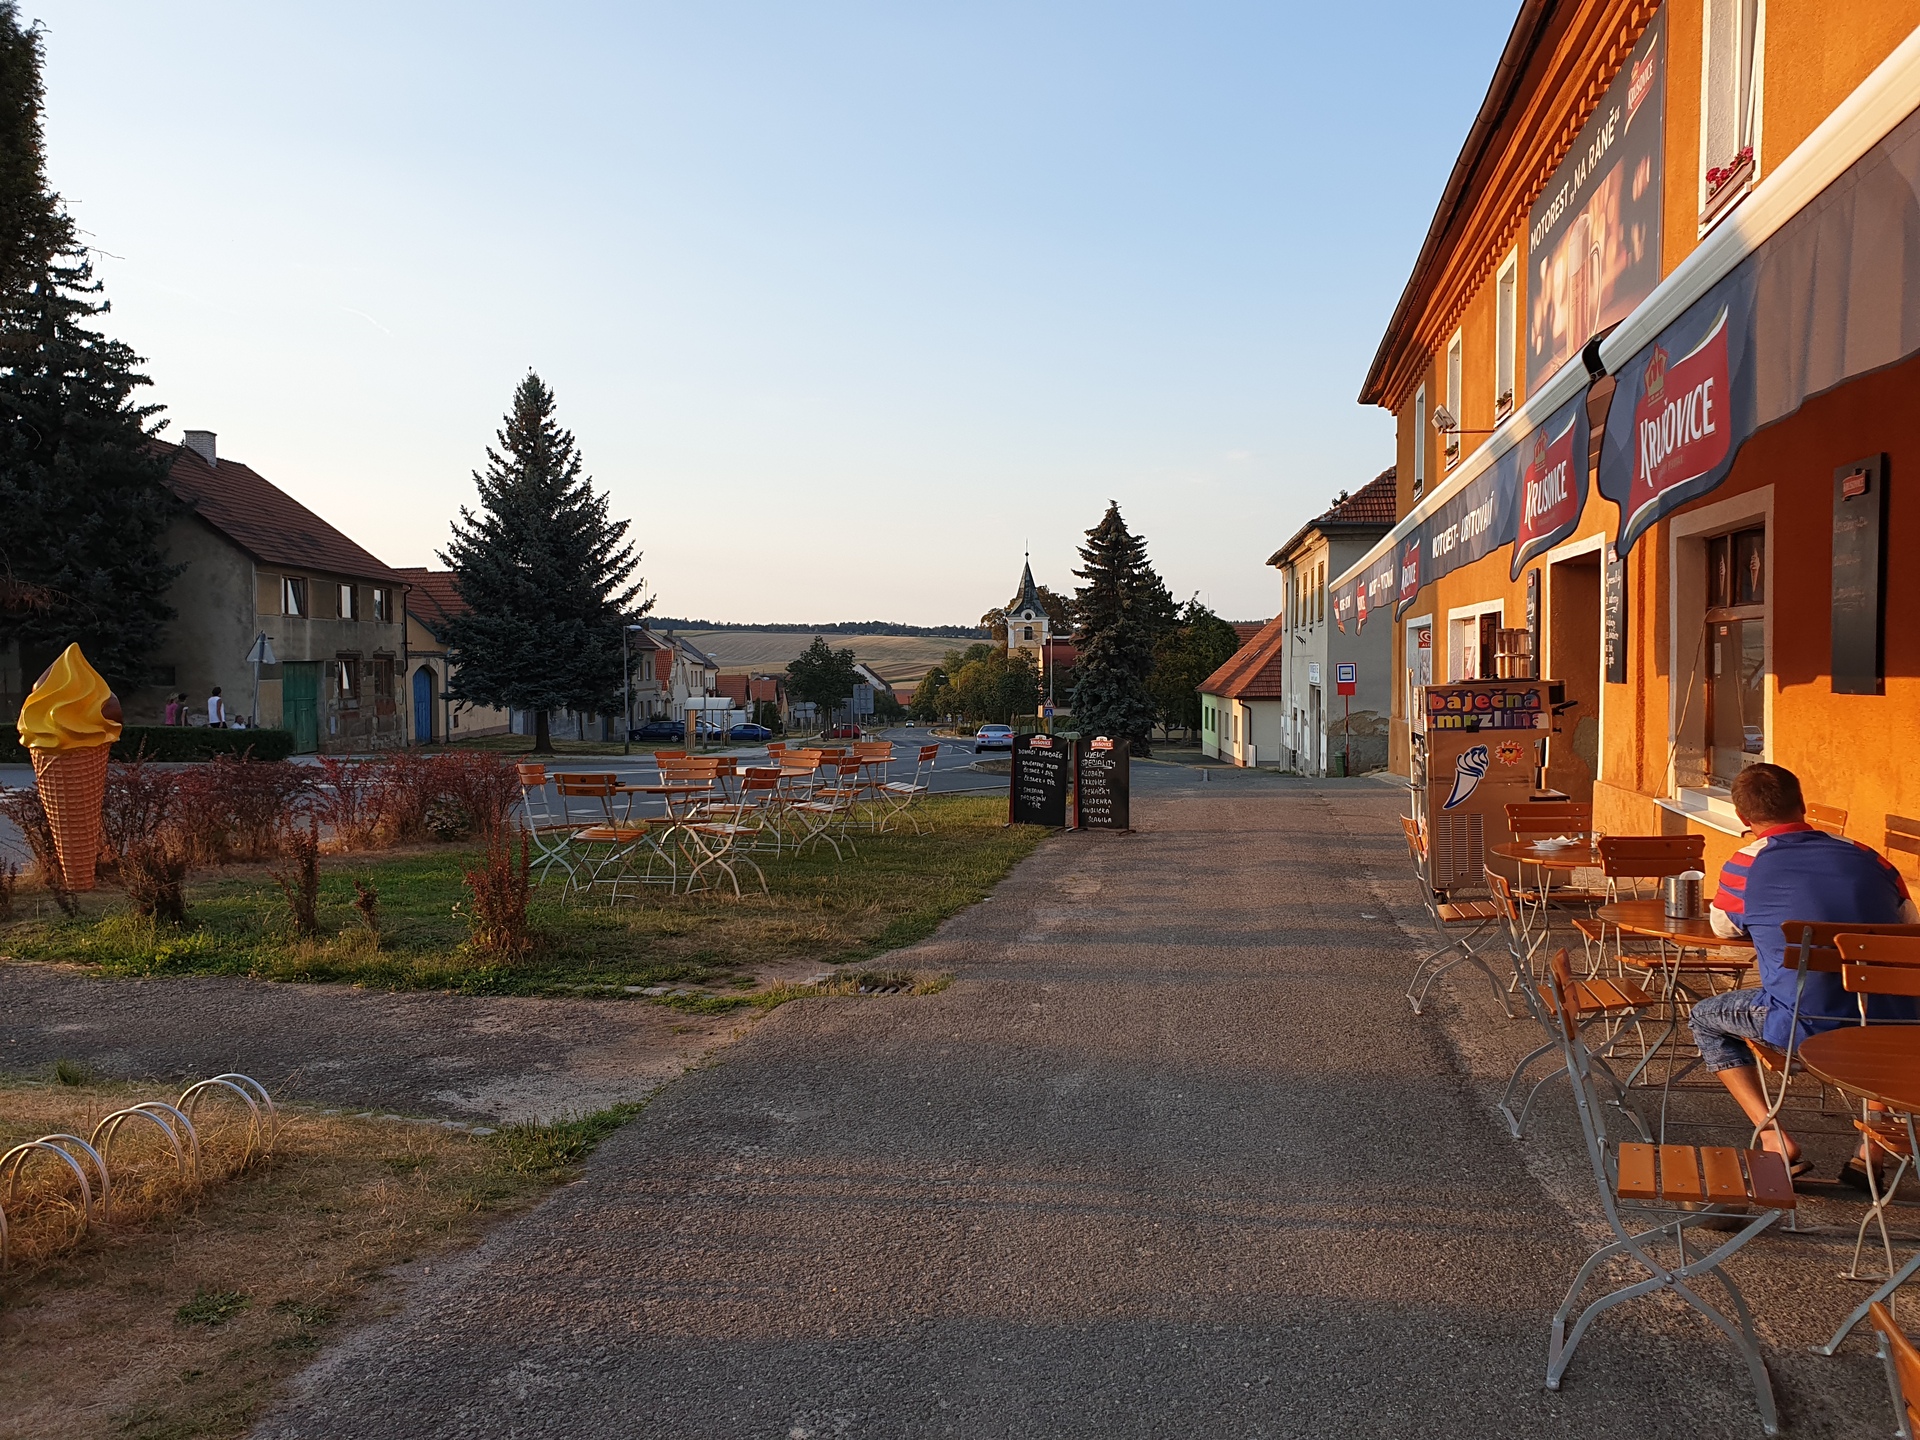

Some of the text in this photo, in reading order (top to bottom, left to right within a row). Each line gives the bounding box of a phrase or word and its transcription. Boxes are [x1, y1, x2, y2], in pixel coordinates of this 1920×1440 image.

[1530, 181, 1569, 254] MOTOREST
[1429, 690, 1540, 712] báječná
[1427, 710, 1549, 729] zmrzlina
